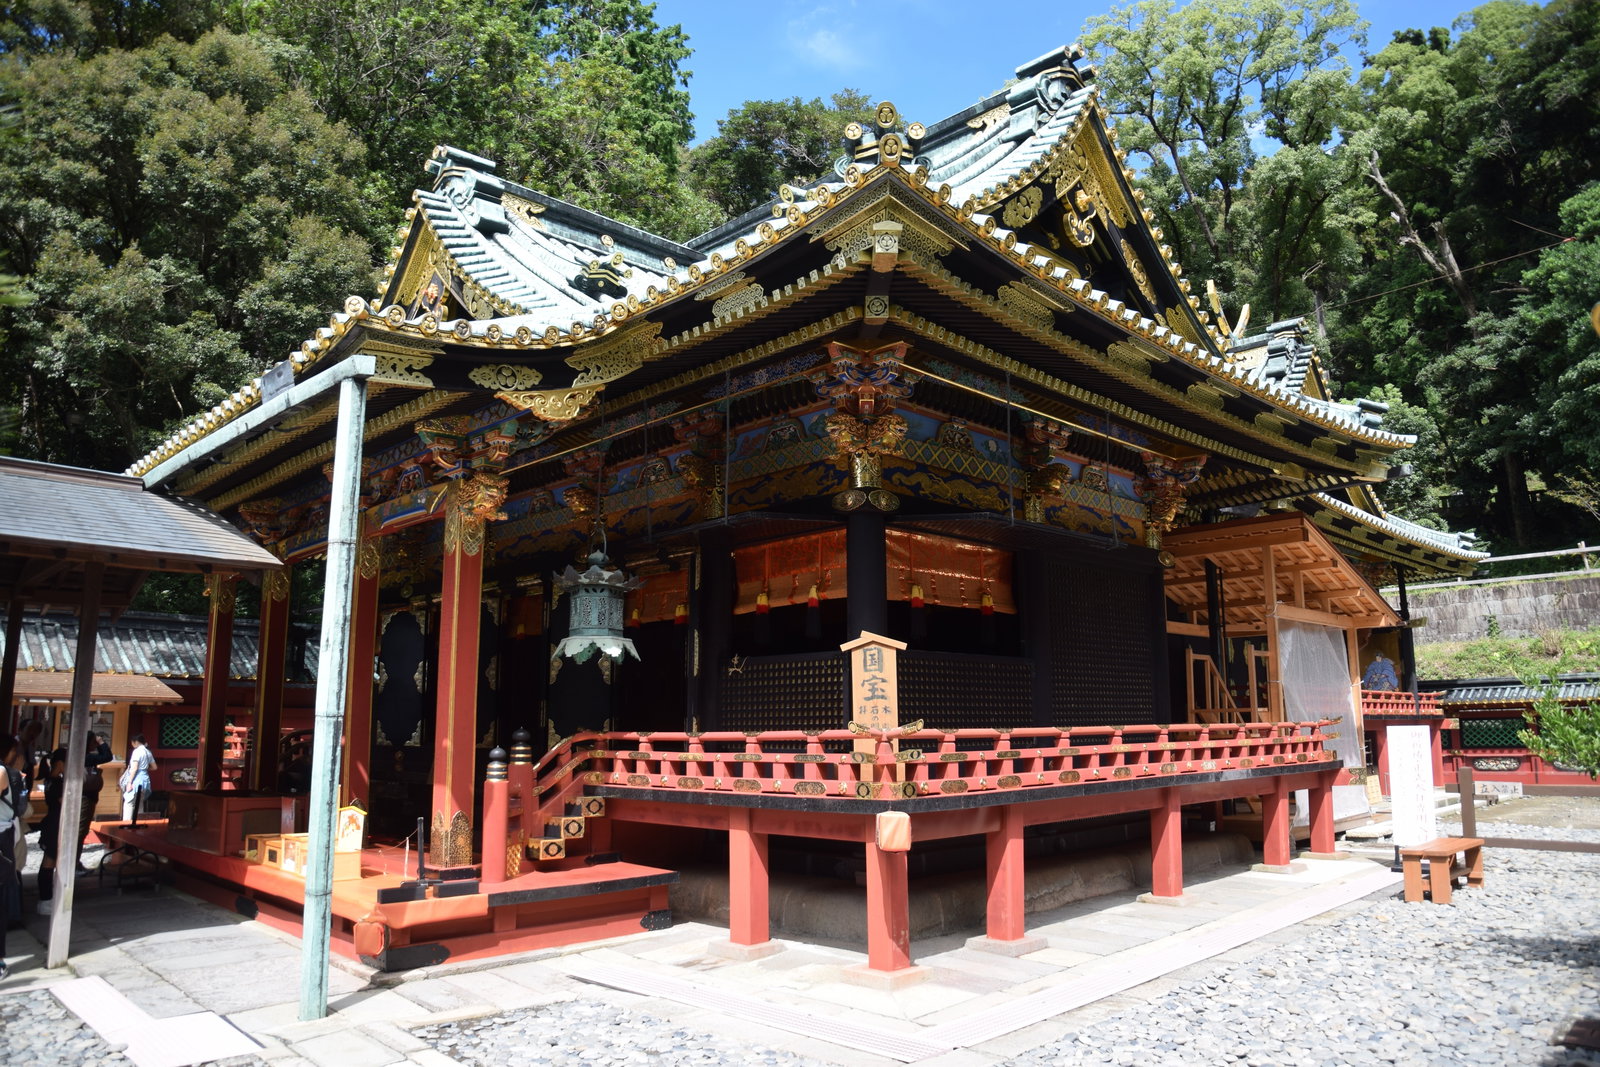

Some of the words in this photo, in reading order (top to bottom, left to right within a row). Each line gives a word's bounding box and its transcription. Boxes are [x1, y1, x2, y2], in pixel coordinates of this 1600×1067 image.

[861, 647, 888, 702] 国宝
[1480, 783, 1519, 795] 立入禁止
